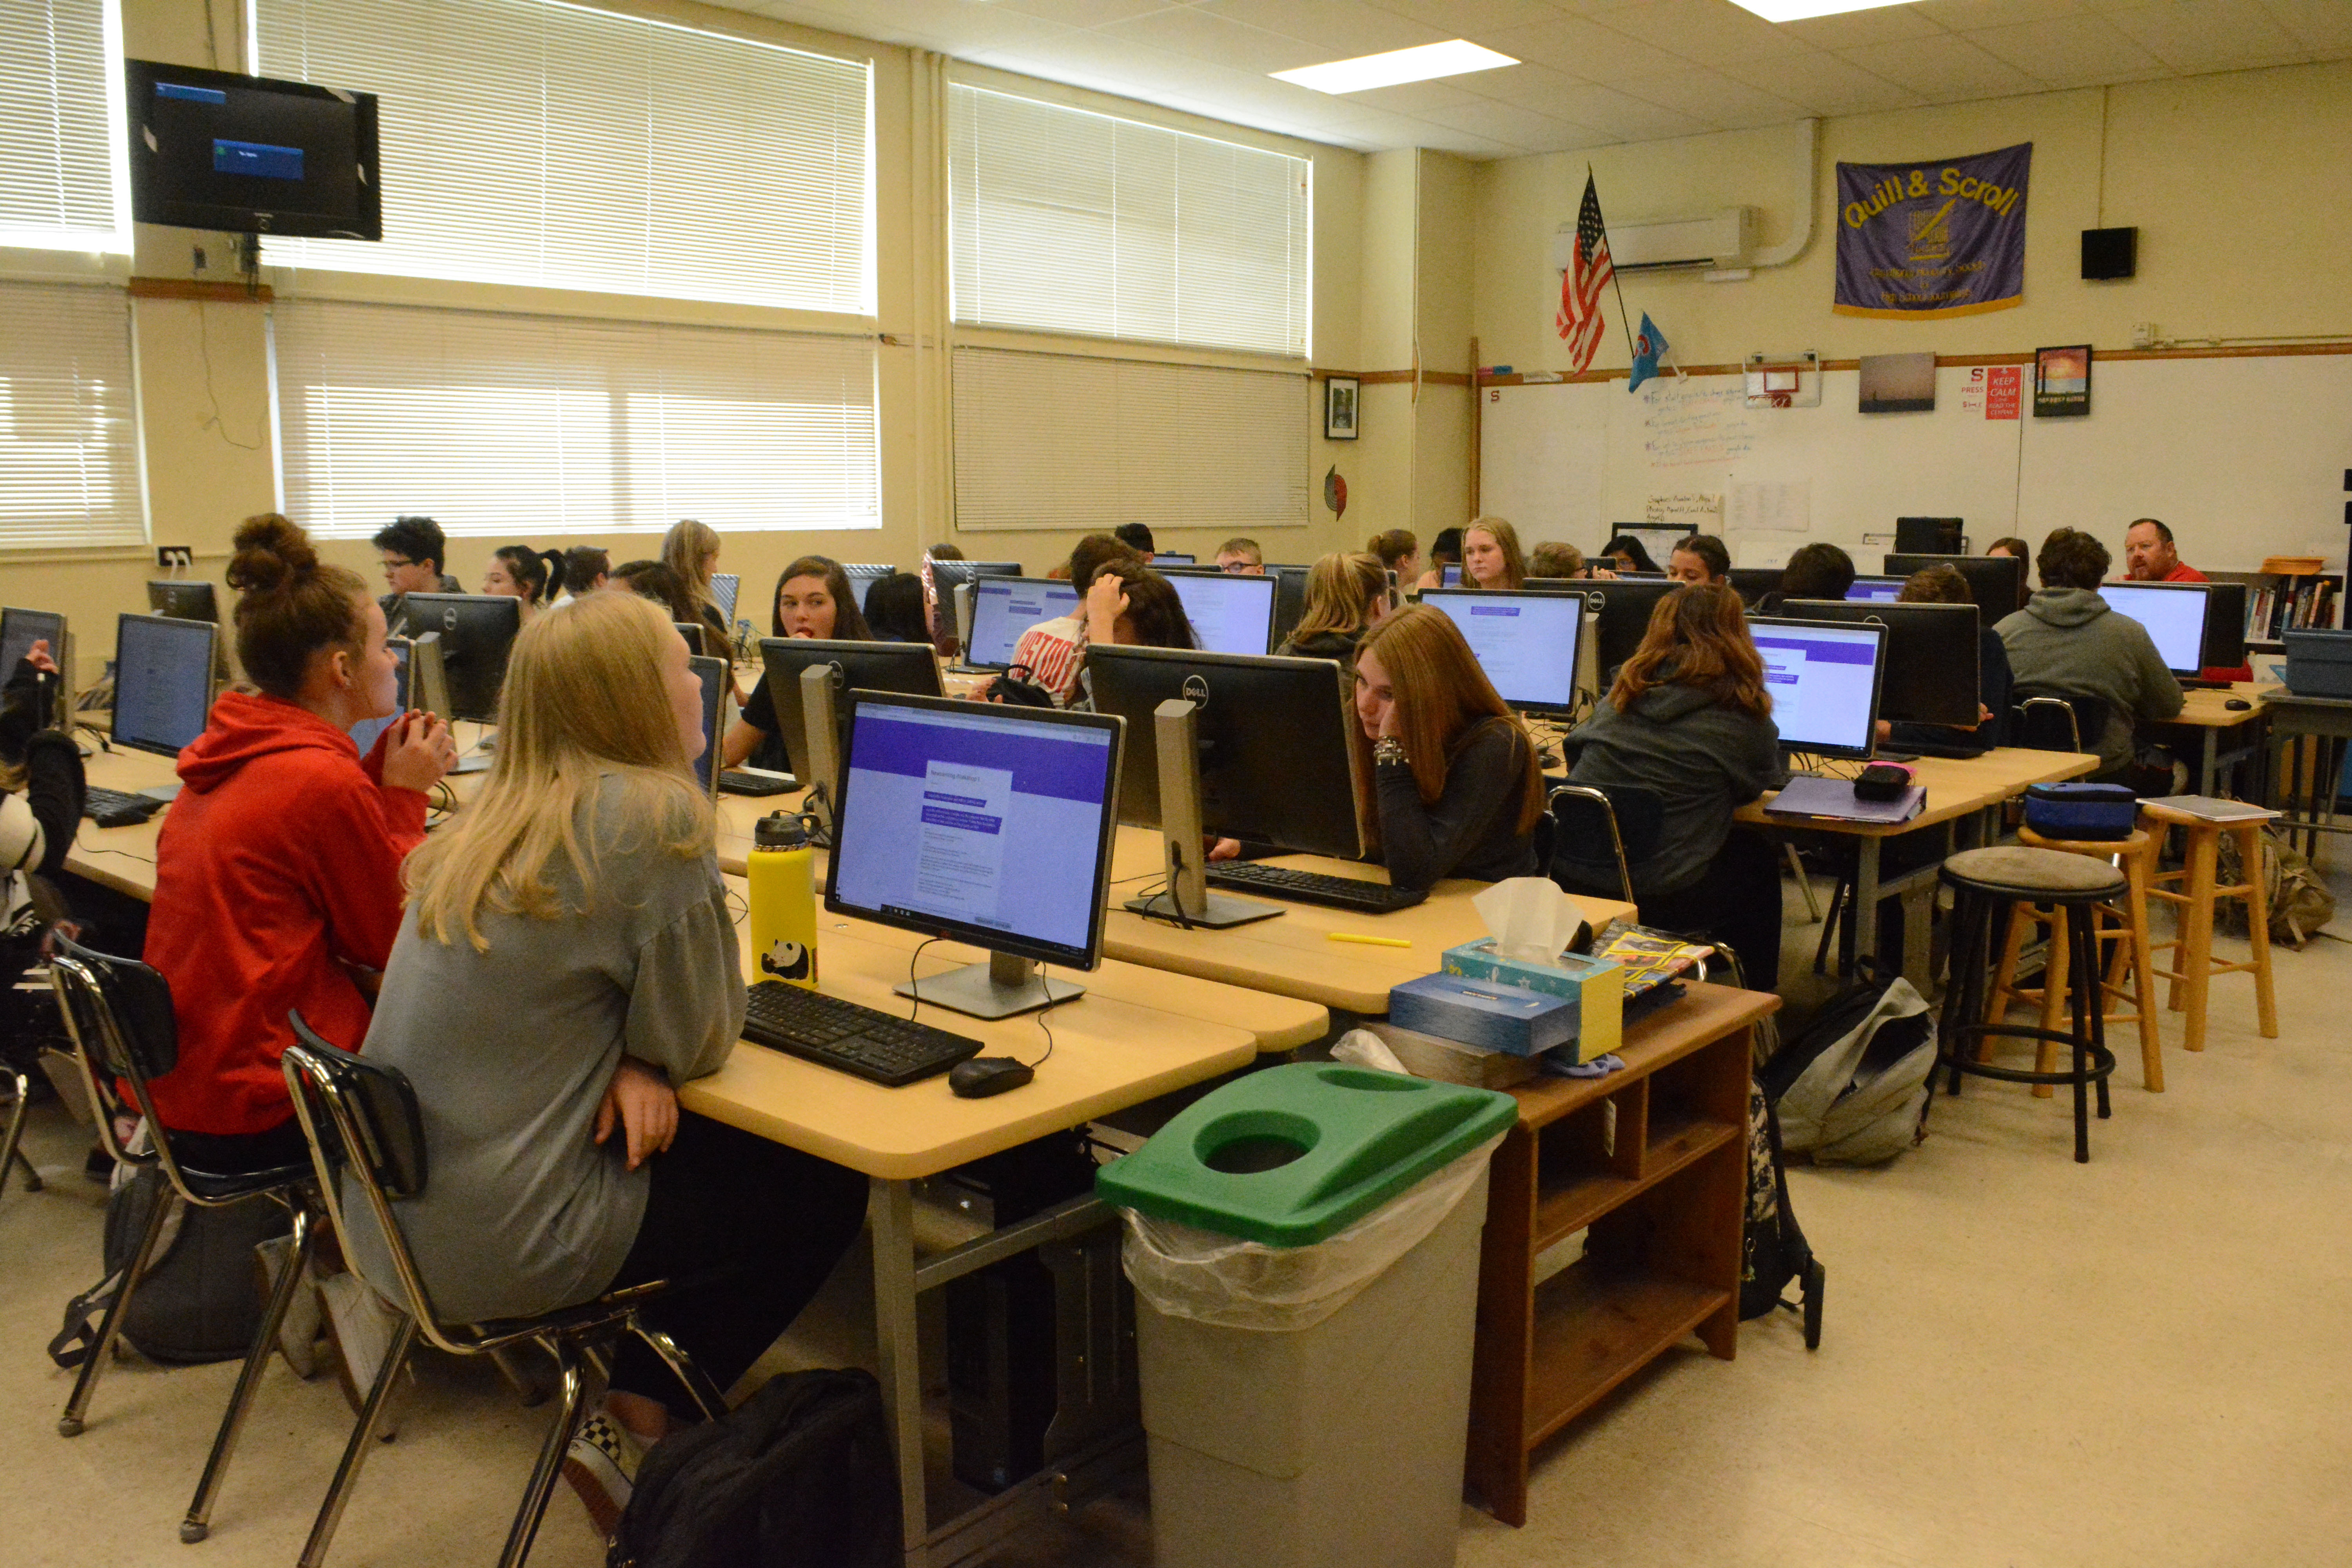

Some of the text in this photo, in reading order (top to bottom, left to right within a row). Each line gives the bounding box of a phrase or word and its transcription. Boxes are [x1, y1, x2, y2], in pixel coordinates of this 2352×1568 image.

[1844, 168, 2020, 229] Quill & Scroll
[1971, 368, 1984, 382] S
[1993, 377, 2015, 385] KEEP
[1491, 390, 1499, 402] S
[1990, 387, 2016, 397] CALM
[1185, 687, 1206, 697] DELL
